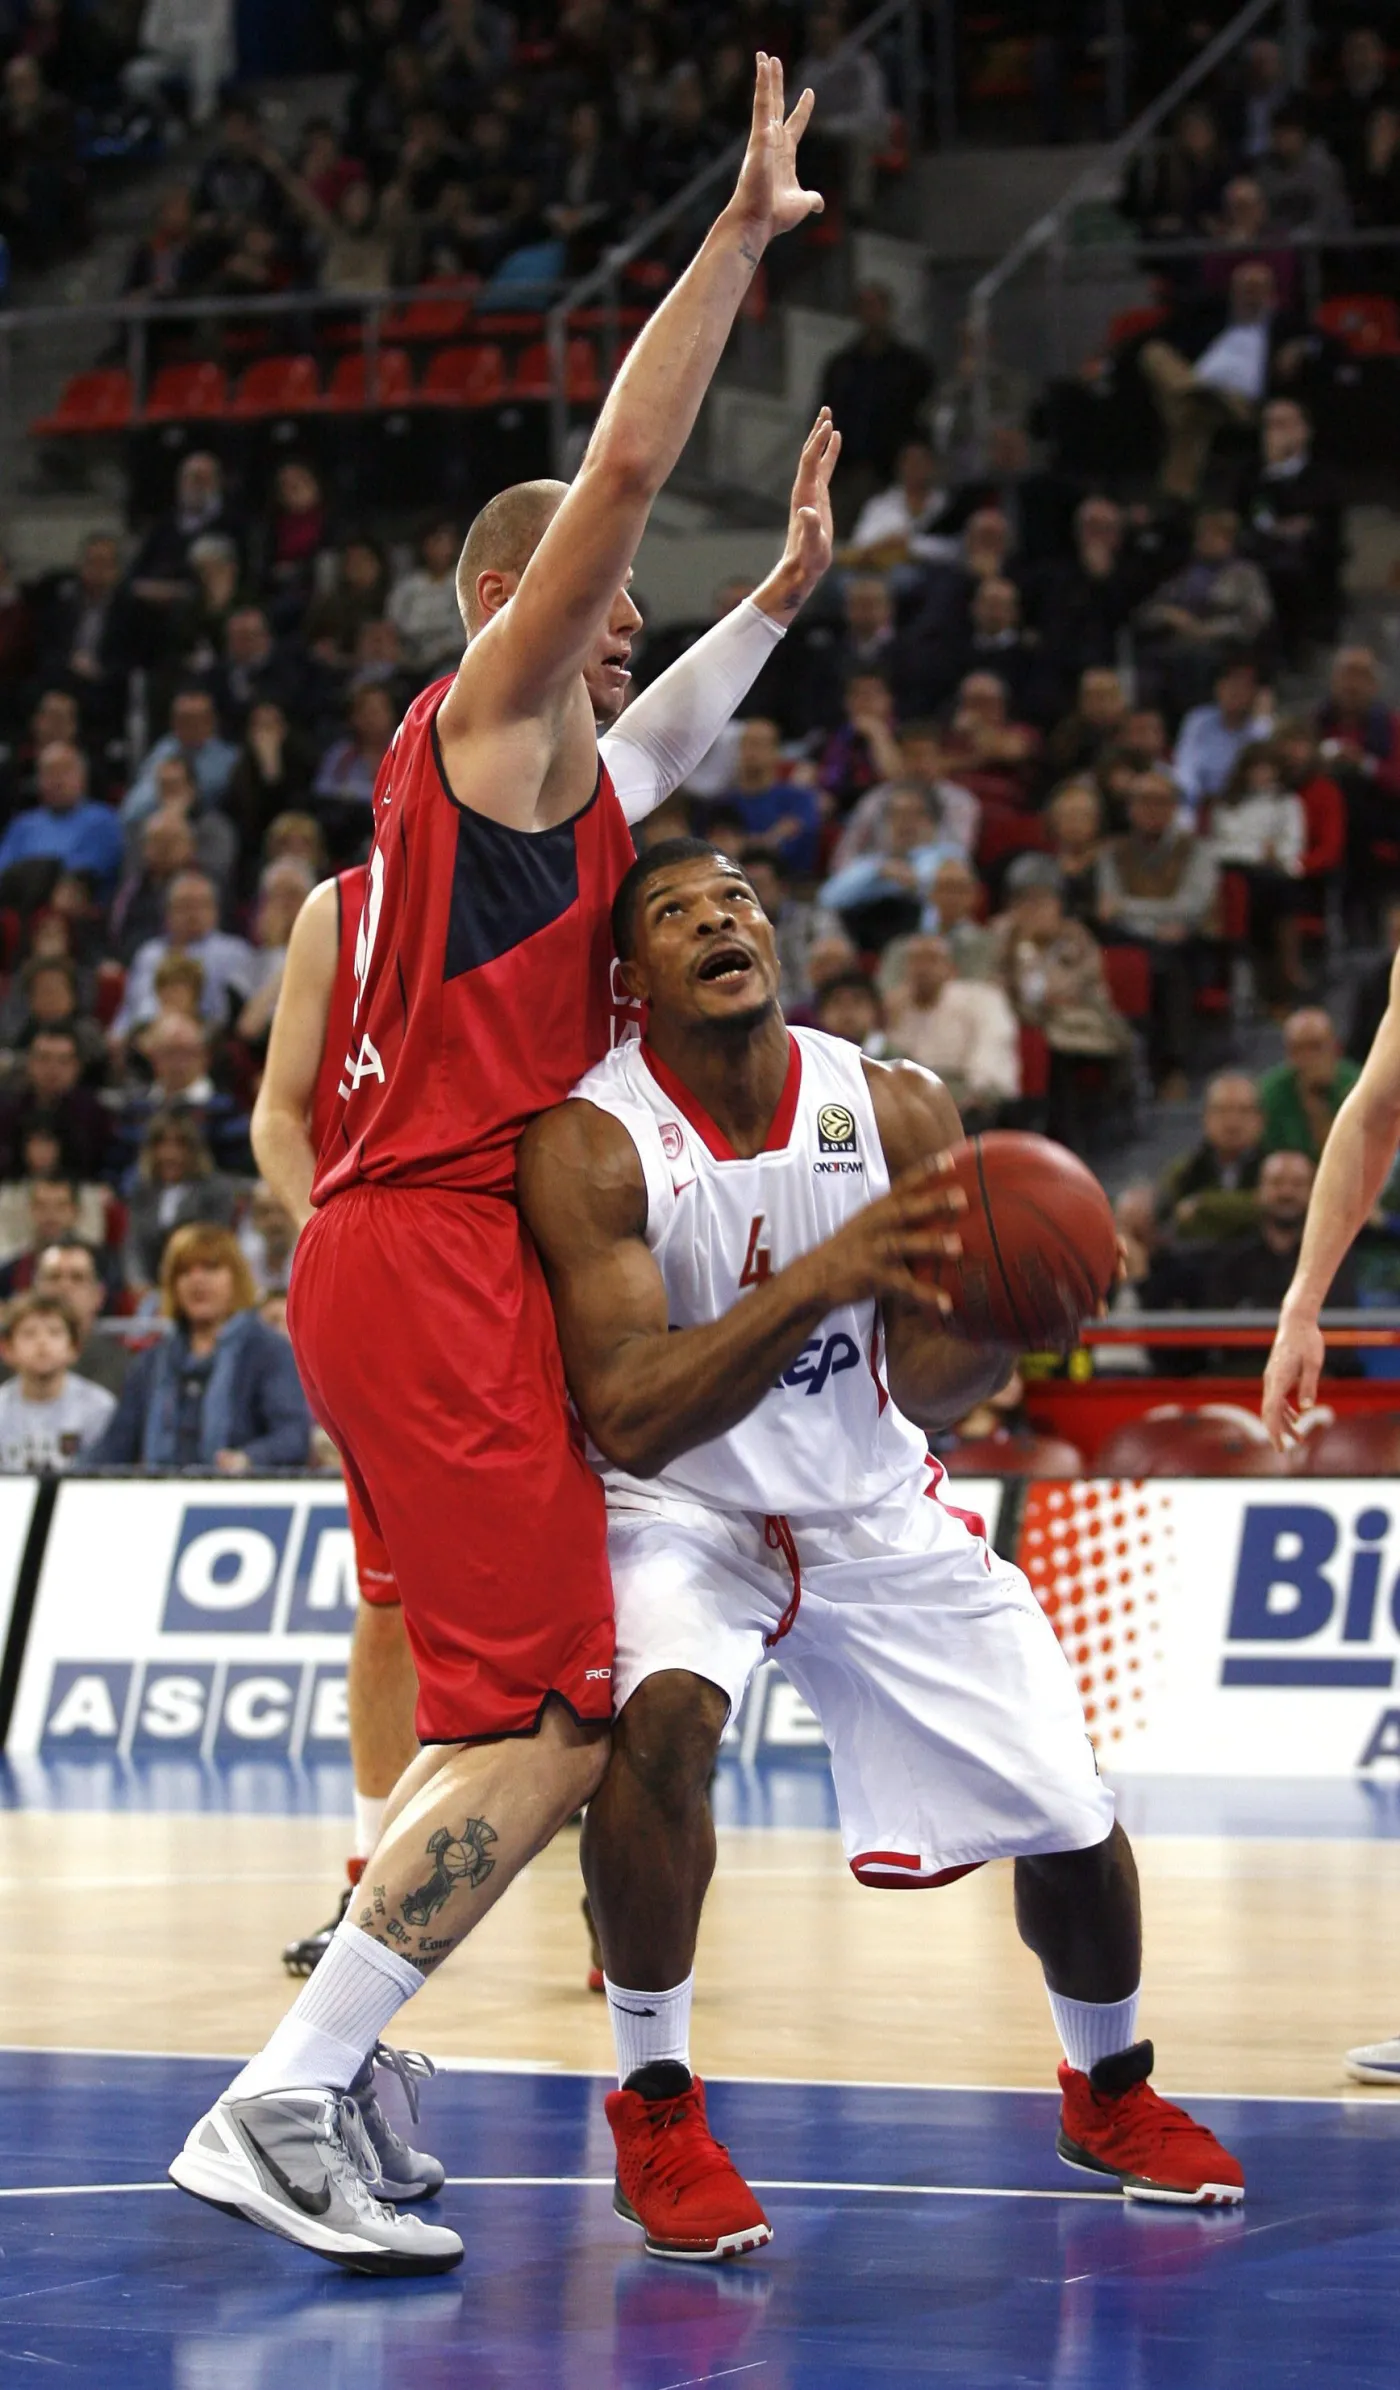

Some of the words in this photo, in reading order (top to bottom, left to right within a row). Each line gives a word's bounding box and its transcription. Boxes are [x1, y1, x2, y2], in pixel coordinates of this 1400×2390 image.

[822, 1142, 855, 1151] 2012
[738, 1214, 776, 1290] 4
[1225, 1502, 1400, 1644] Bi
